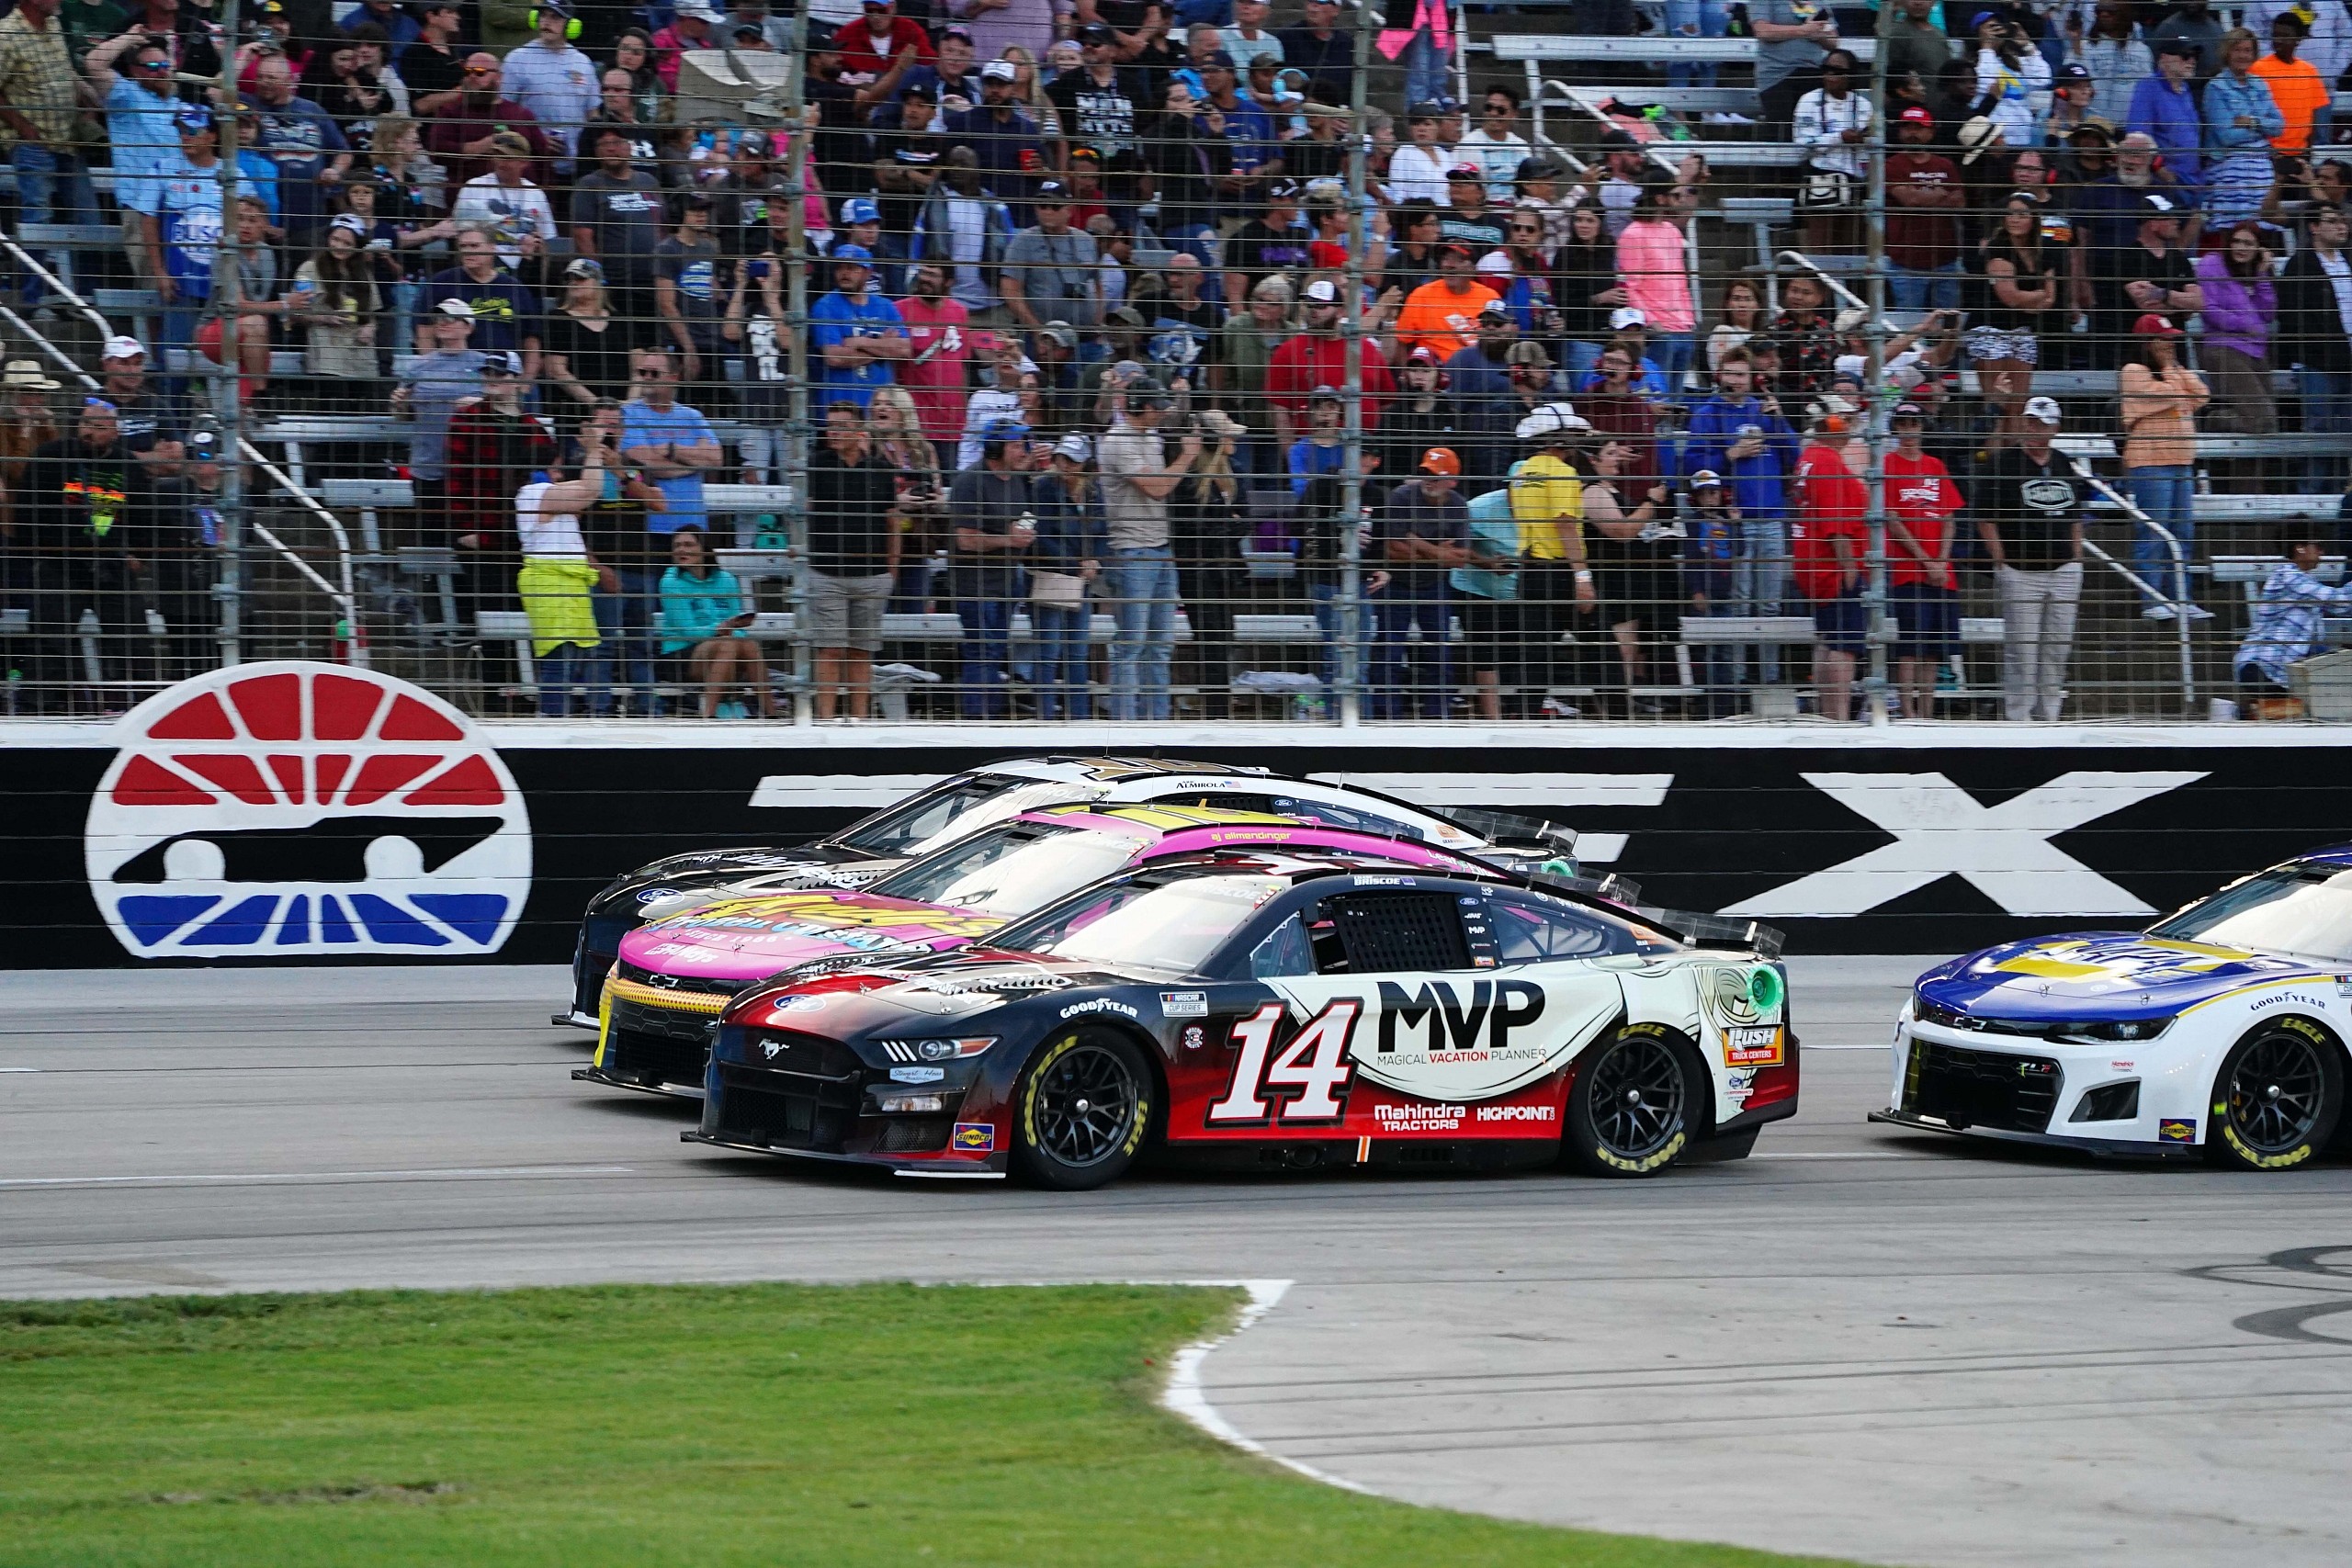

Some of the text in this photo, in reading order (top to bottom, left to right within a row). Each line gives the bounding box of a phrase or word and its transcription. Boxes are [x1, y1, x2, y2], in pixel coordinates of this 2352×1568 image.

[1211, 831, 1292, 842] aj allmendinger
[1354, 877, 1400, 886] BRISCOE
[1468, 926, 1486, 934] MVP
[1059, 998, 1138, 1019] GOODYEAR
[1378, 979, 1544, 1053] MVP
[1728, 1028, 1777, 1052] RUSH
[1206, 998, 1360, 1124] 14
[1377, 1048, 1547, 1066] MAGICAL VACATION PLANNER
[1732, 1049, 1772, 1061] TRUCK CENTERS
[1374, 1103, 1466, 1120] Mahindra
[1476, 1106, 1550, 1122] HIGHPOINT
[1383, 1119, 1459, 1132] TRACTORS
[2161, 1126, 2195, 1135] SUNOCO
[956, 1133, 991, 1143] SUNOCO
